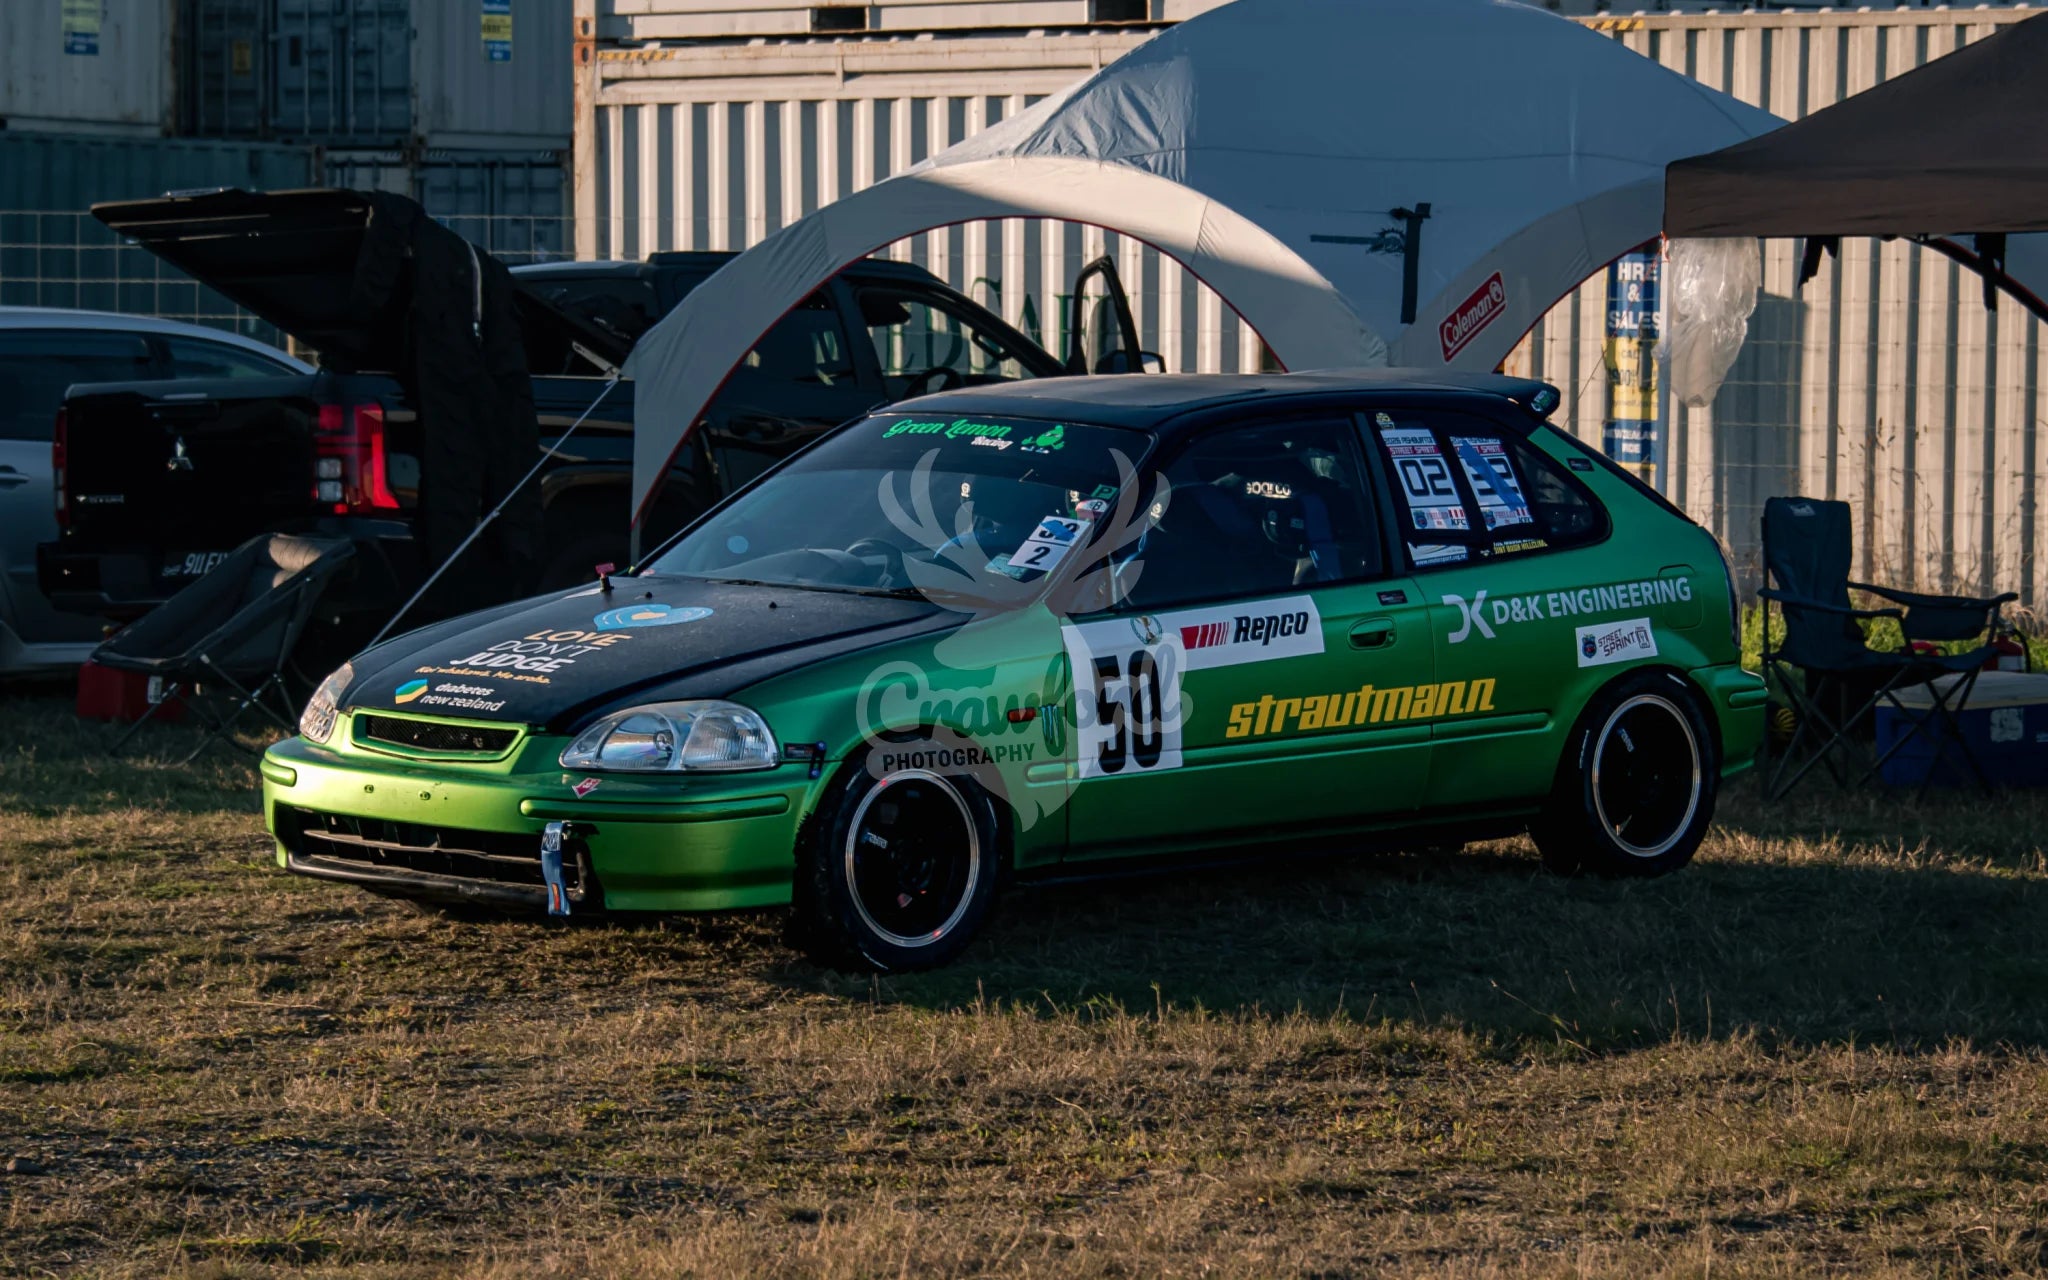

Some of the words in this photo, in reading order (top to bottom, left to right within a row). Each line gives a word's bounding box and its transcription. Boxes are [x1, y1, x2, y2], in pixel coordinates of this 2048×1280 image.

[1628, 283, 1640, 302] &
[1444, 294, 1492, 348] Coleman
[1608, 311, 1660, 330] SALES
[882, 419, 945, 438] Green
[944, 419, 1012, 439] Lemon
[971, 436, 1013, 450] Racing
[1399, 459, 1454, 496] 02
[1450, 518, 1467, 526] KFC
[1025, 546, 1051, 566] 2
[1492, 594, 1545, 625] D&K
[1546, 577, 1692, 618] ENGINEERING
[524, 629, 633, 648] LOVE
[1233, 611, 1309, 646] Repco
[1597, 628, 1622, 648] STREET
[487, 640, 602, 658] DON'T
[1603, 632, 1637, 657] SPRINT
[450, 652, 576, 673] JUDGE
[434, 682, 496, 697] diabetes
[419, 693, 449, 706] new
[448, 695, 505, 713] zealand
[1092, 649, 1163, 774] 50
[1225, 677, 1496, 739] strautmann
